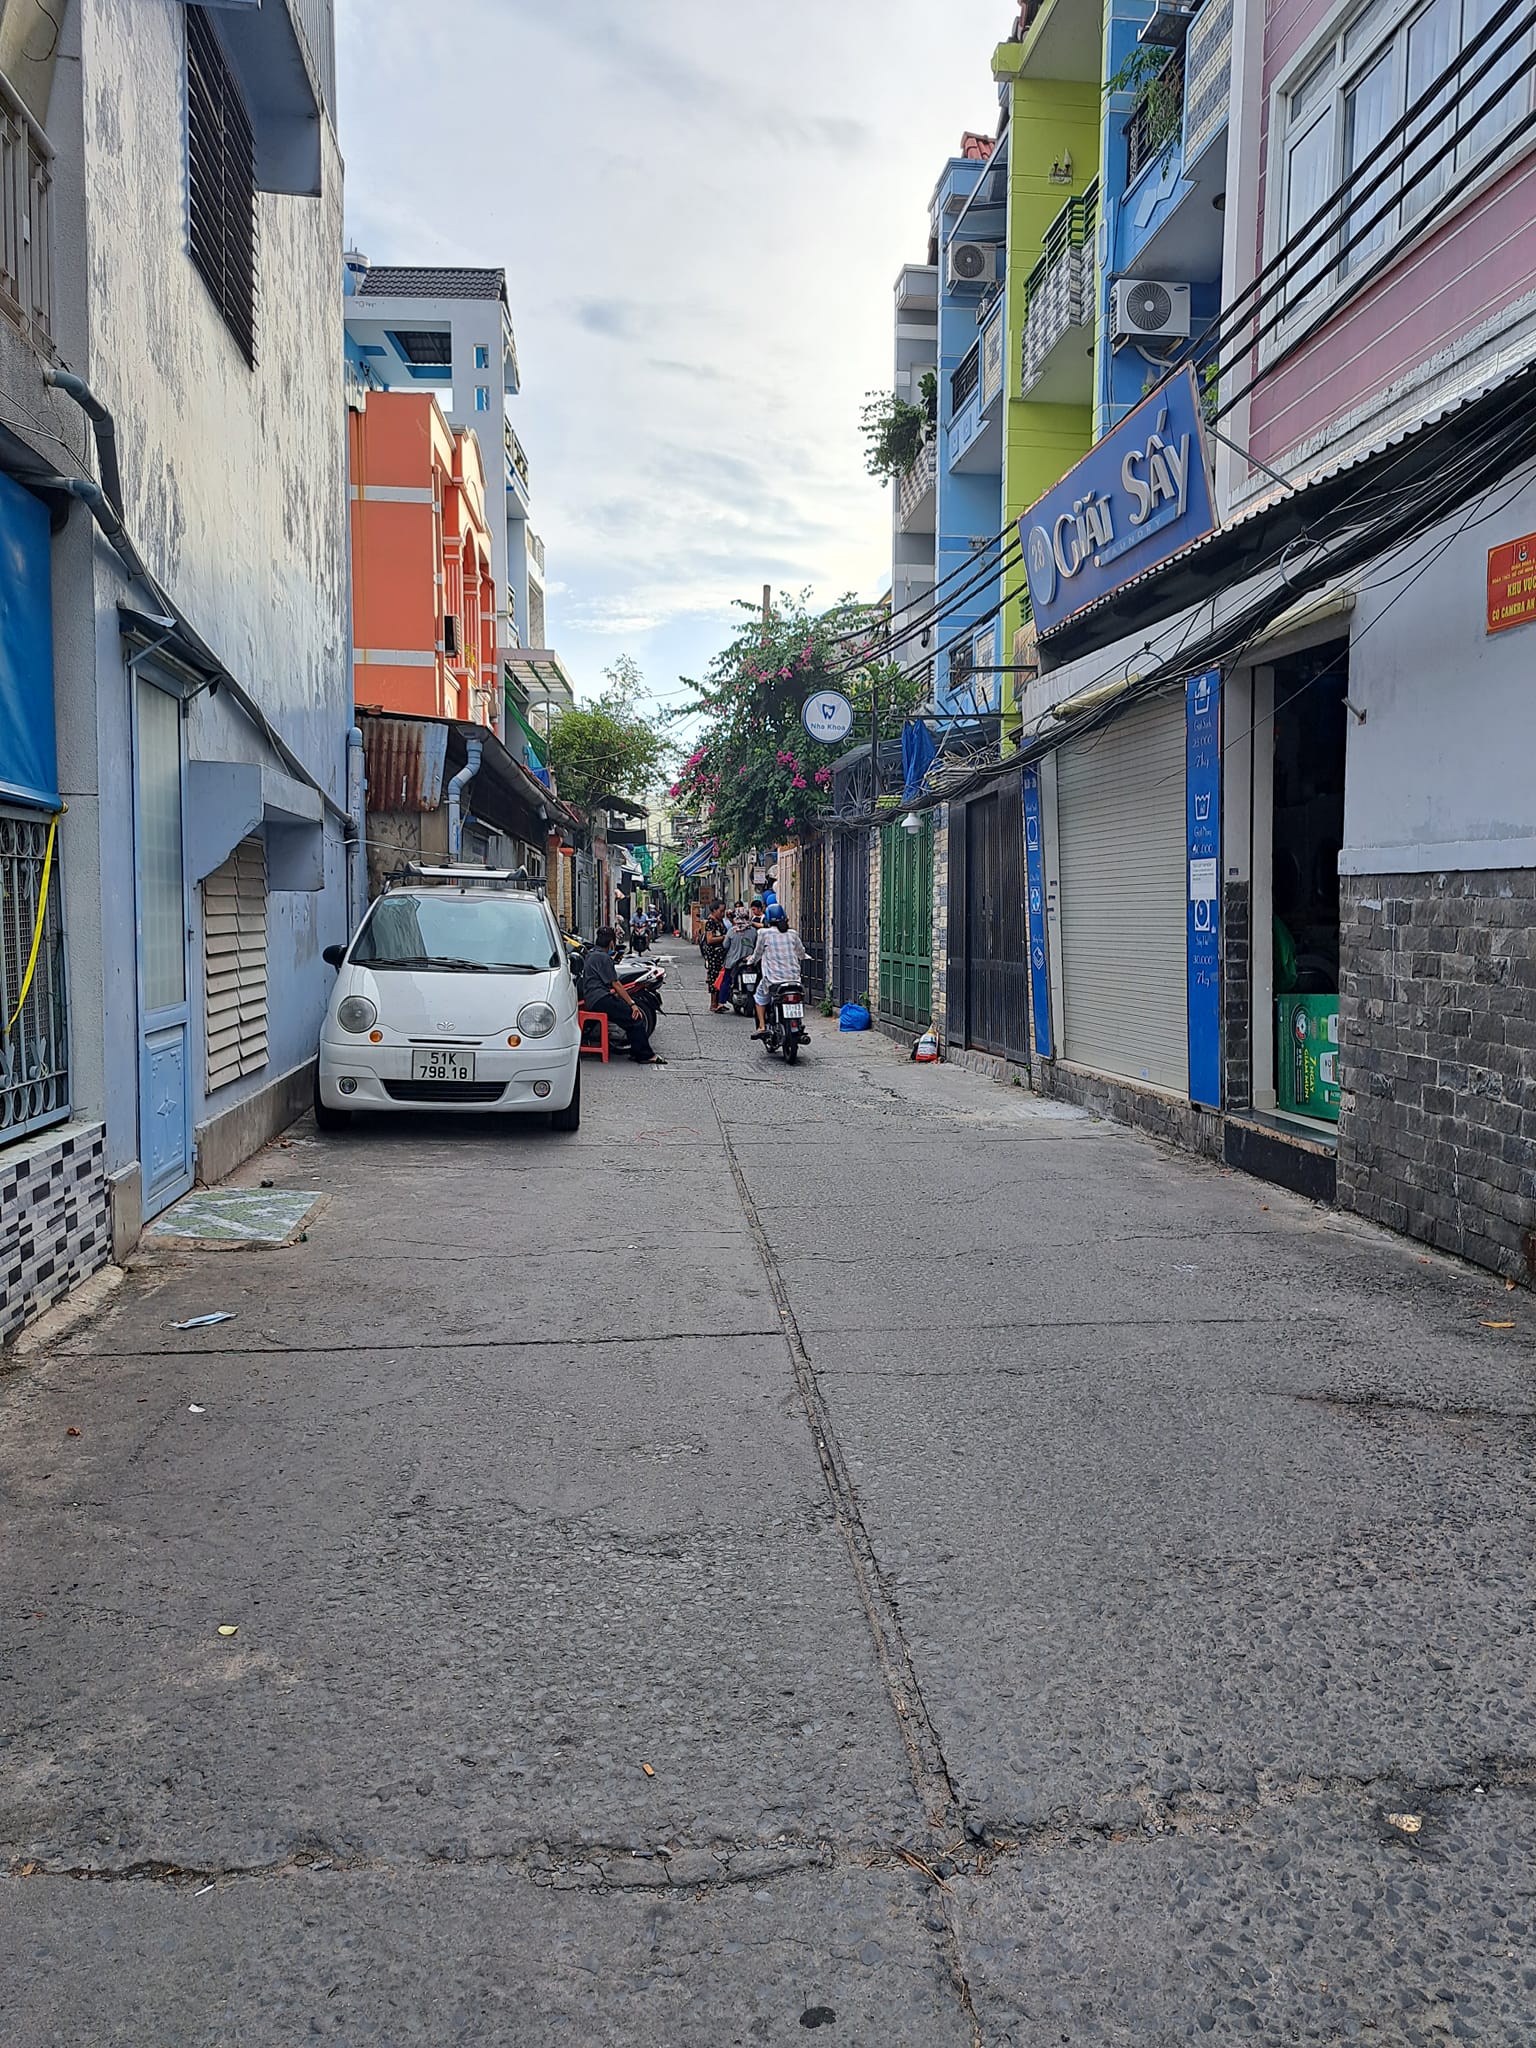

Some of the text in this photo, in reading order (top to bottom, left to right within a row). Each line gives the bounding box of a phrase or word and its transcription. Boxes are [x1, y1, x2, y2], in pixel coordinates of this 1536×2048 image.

[1031, 540, 1046, 573] 28
[1501, 600, 1526, 619] CAMERA
[430, 1052, 457, 1066] 51K
[419, 1066, 468, 1080] 798.18
